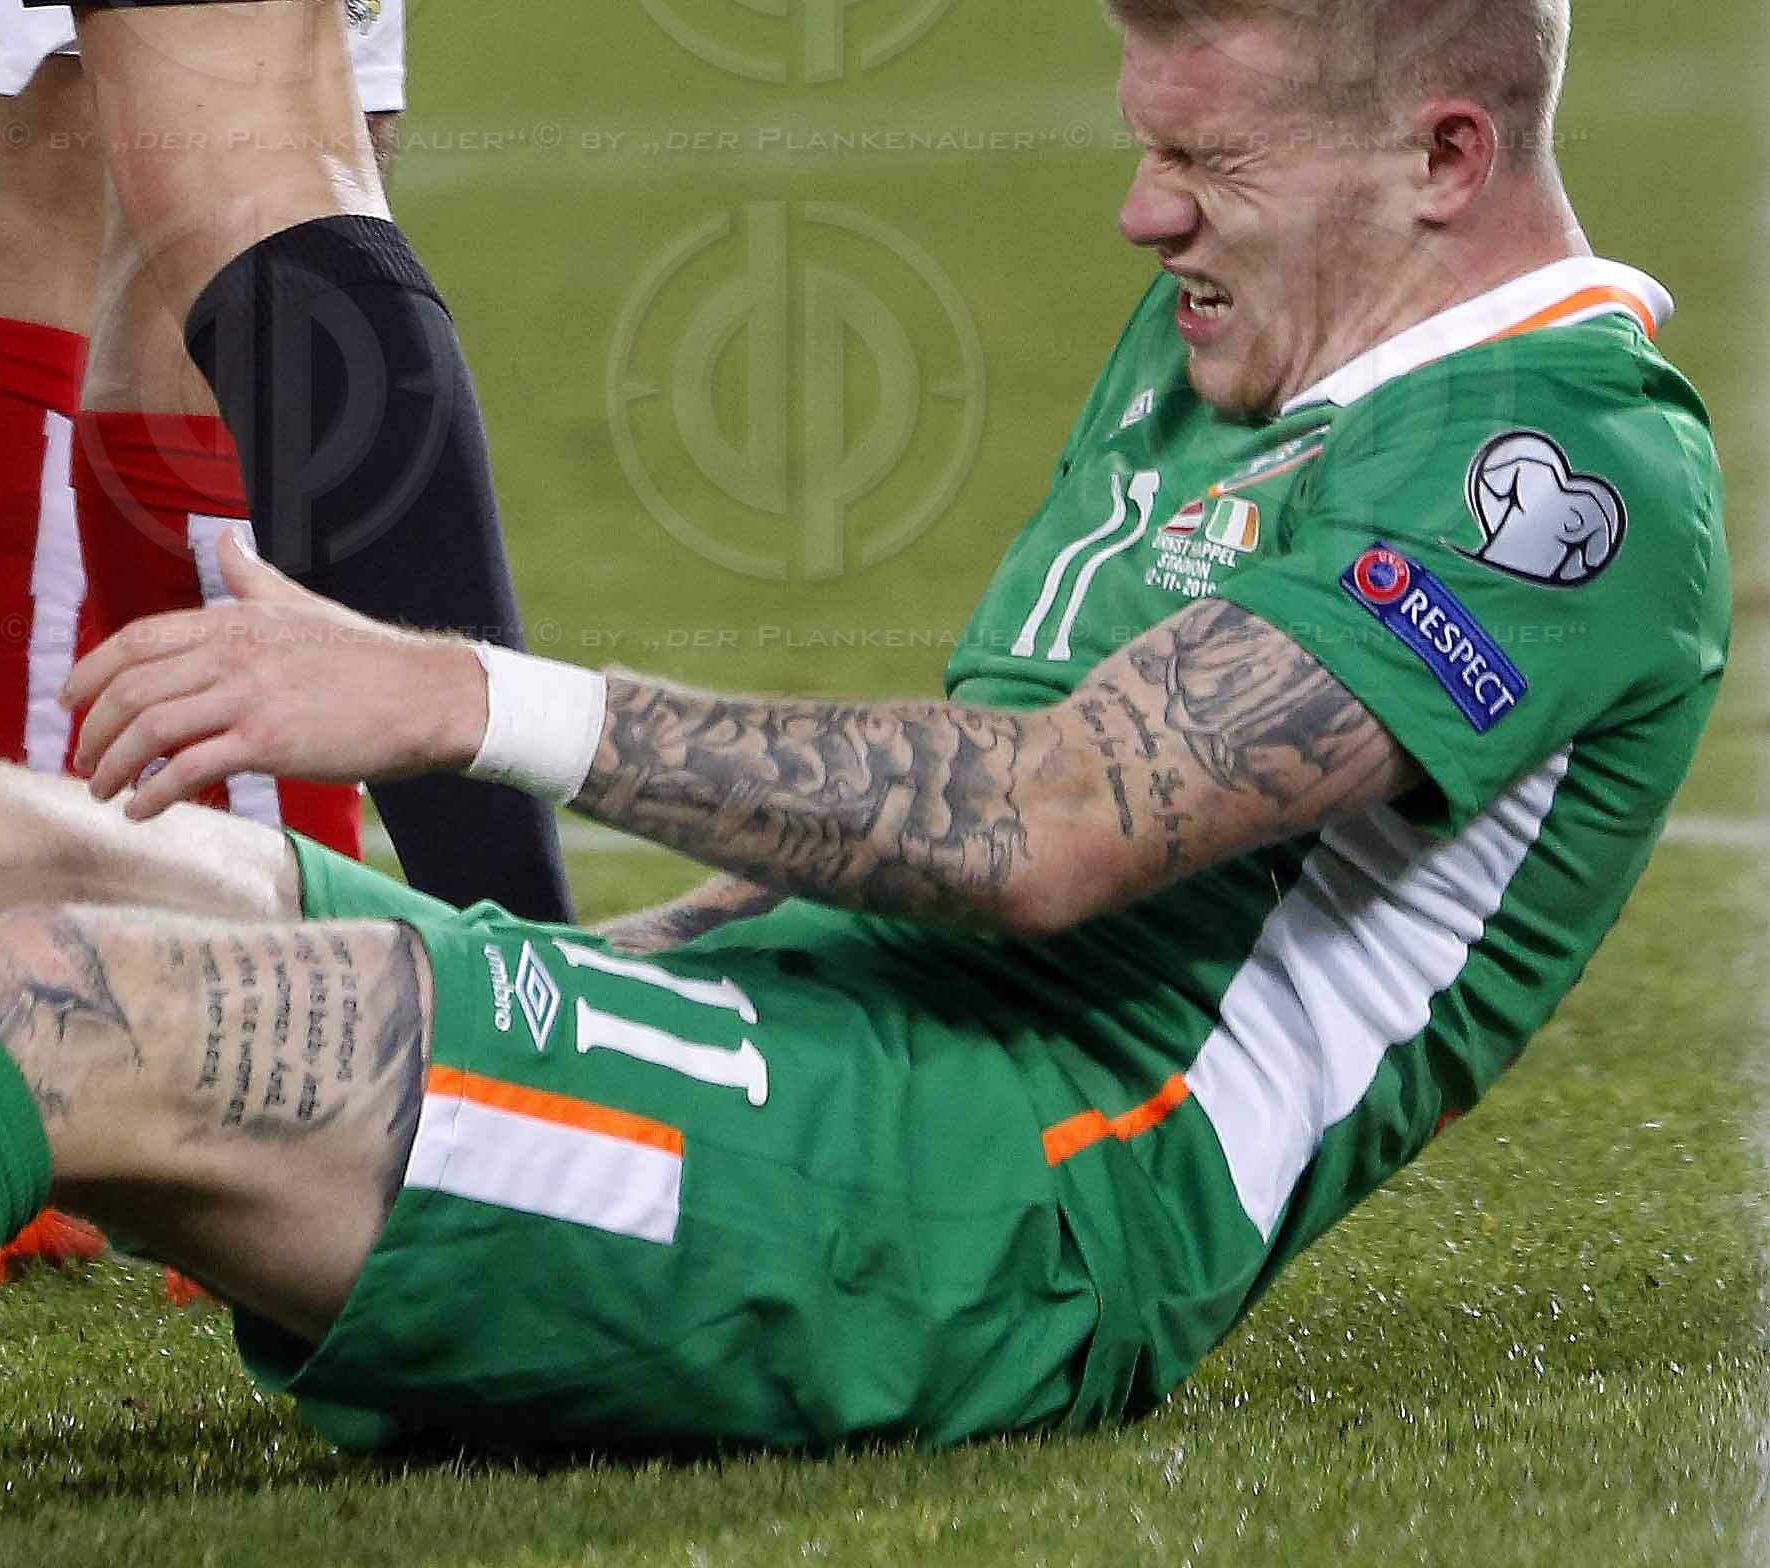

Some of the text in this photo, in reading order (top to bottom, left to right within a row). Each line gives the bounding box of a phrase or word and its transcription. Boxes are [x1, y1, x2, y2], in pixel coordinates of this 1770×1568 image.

[1010, 469, 1161, 662] 11
[1399, 587, 1517, 716] RESPECT
[552, 938, 769, 1107] 11
